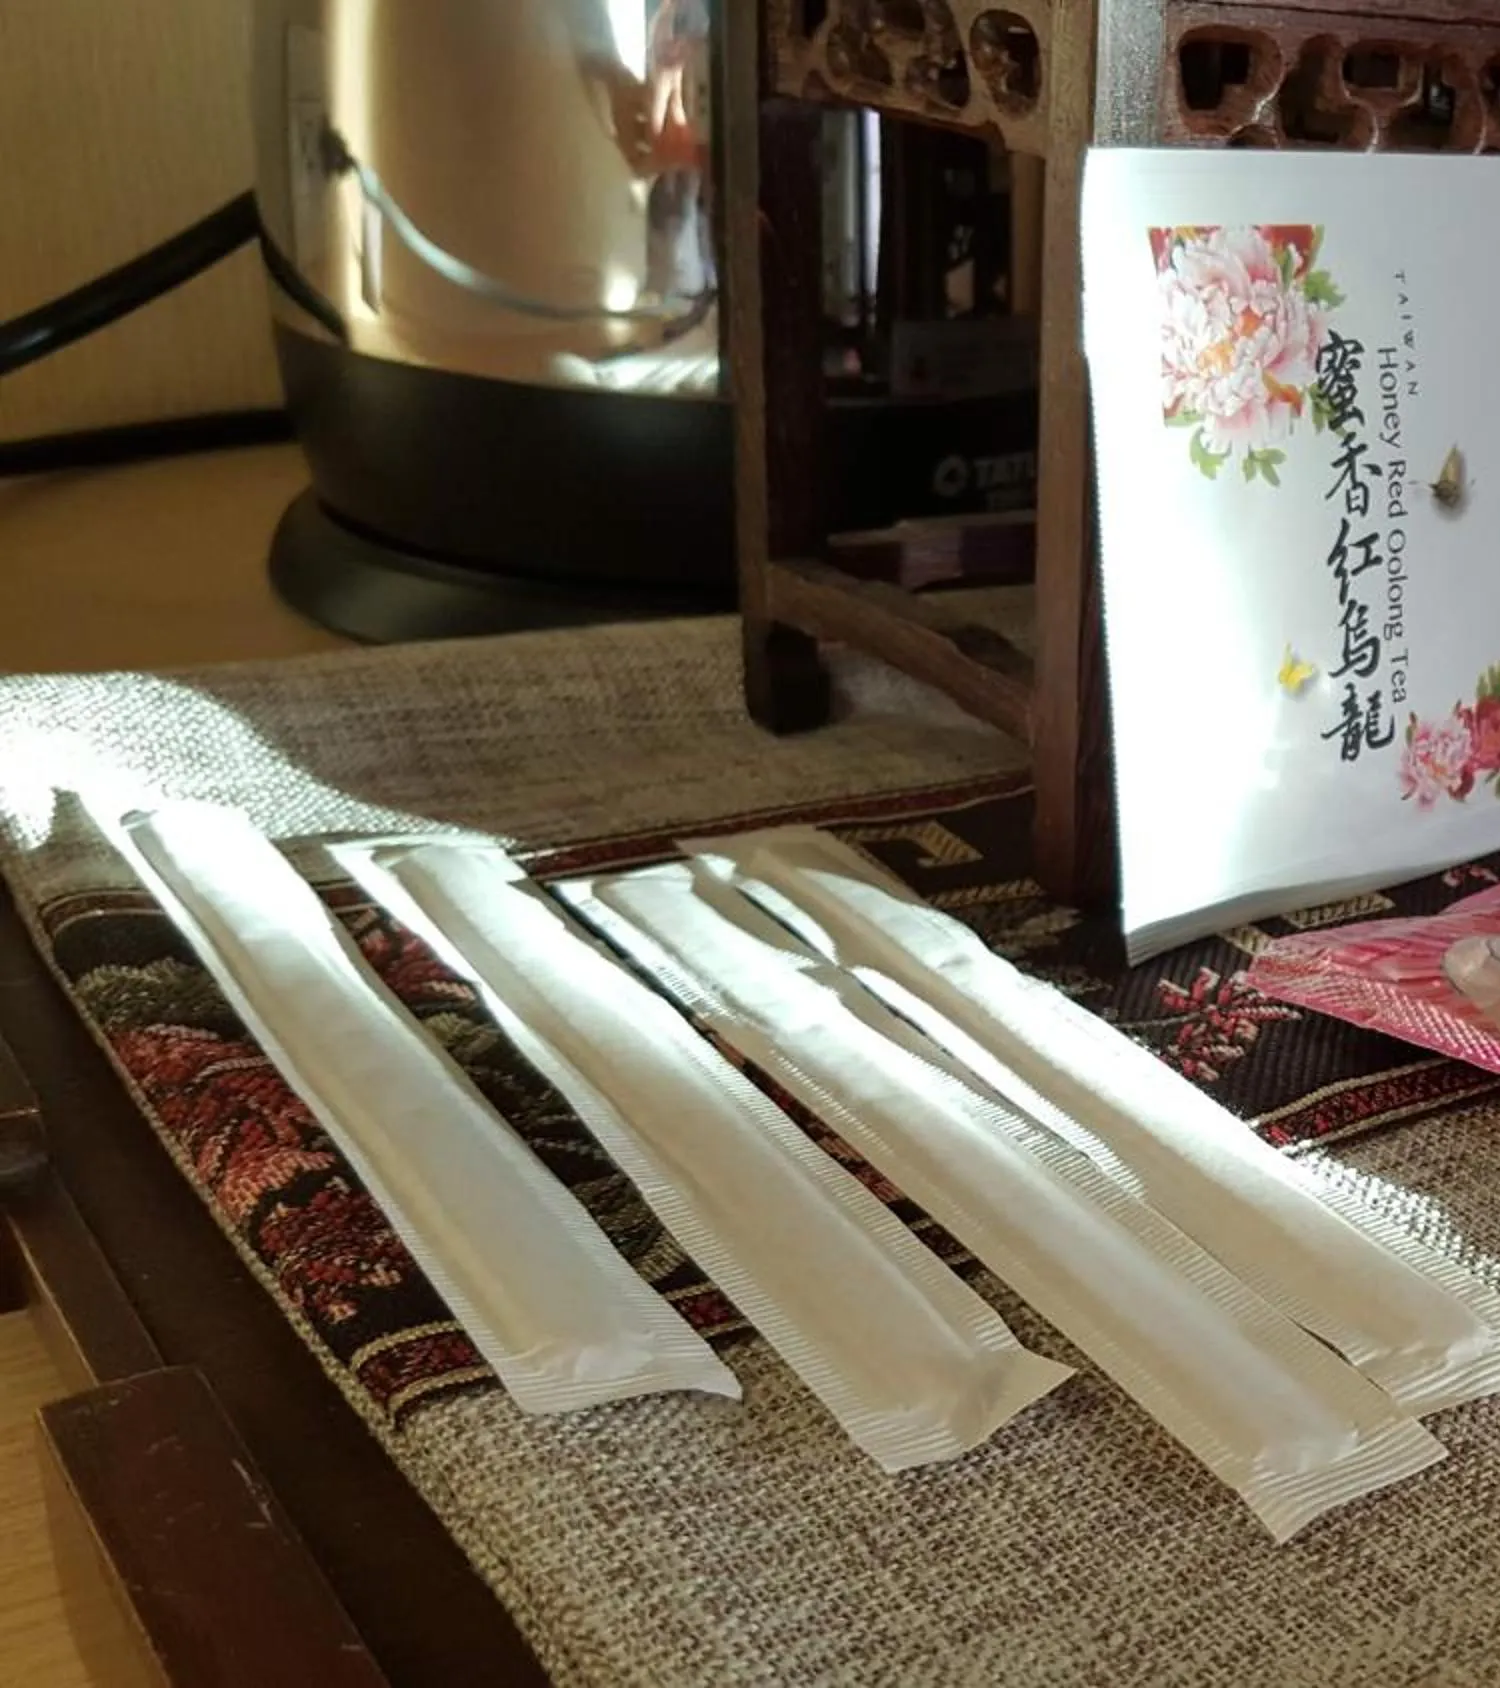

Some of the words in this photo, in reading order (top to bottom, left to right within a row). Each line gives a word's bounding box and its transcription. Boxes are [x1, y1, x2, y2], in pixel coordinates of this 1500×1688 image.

[1394, 269, 1419, 396] TAIWAN
[1377, 347, 1402, 449] Honey
[1387, 459, 1409, 518] Red
[1383, 528, 1409, 641] Oolong
[1390, 647, 1409, 704] Tea
